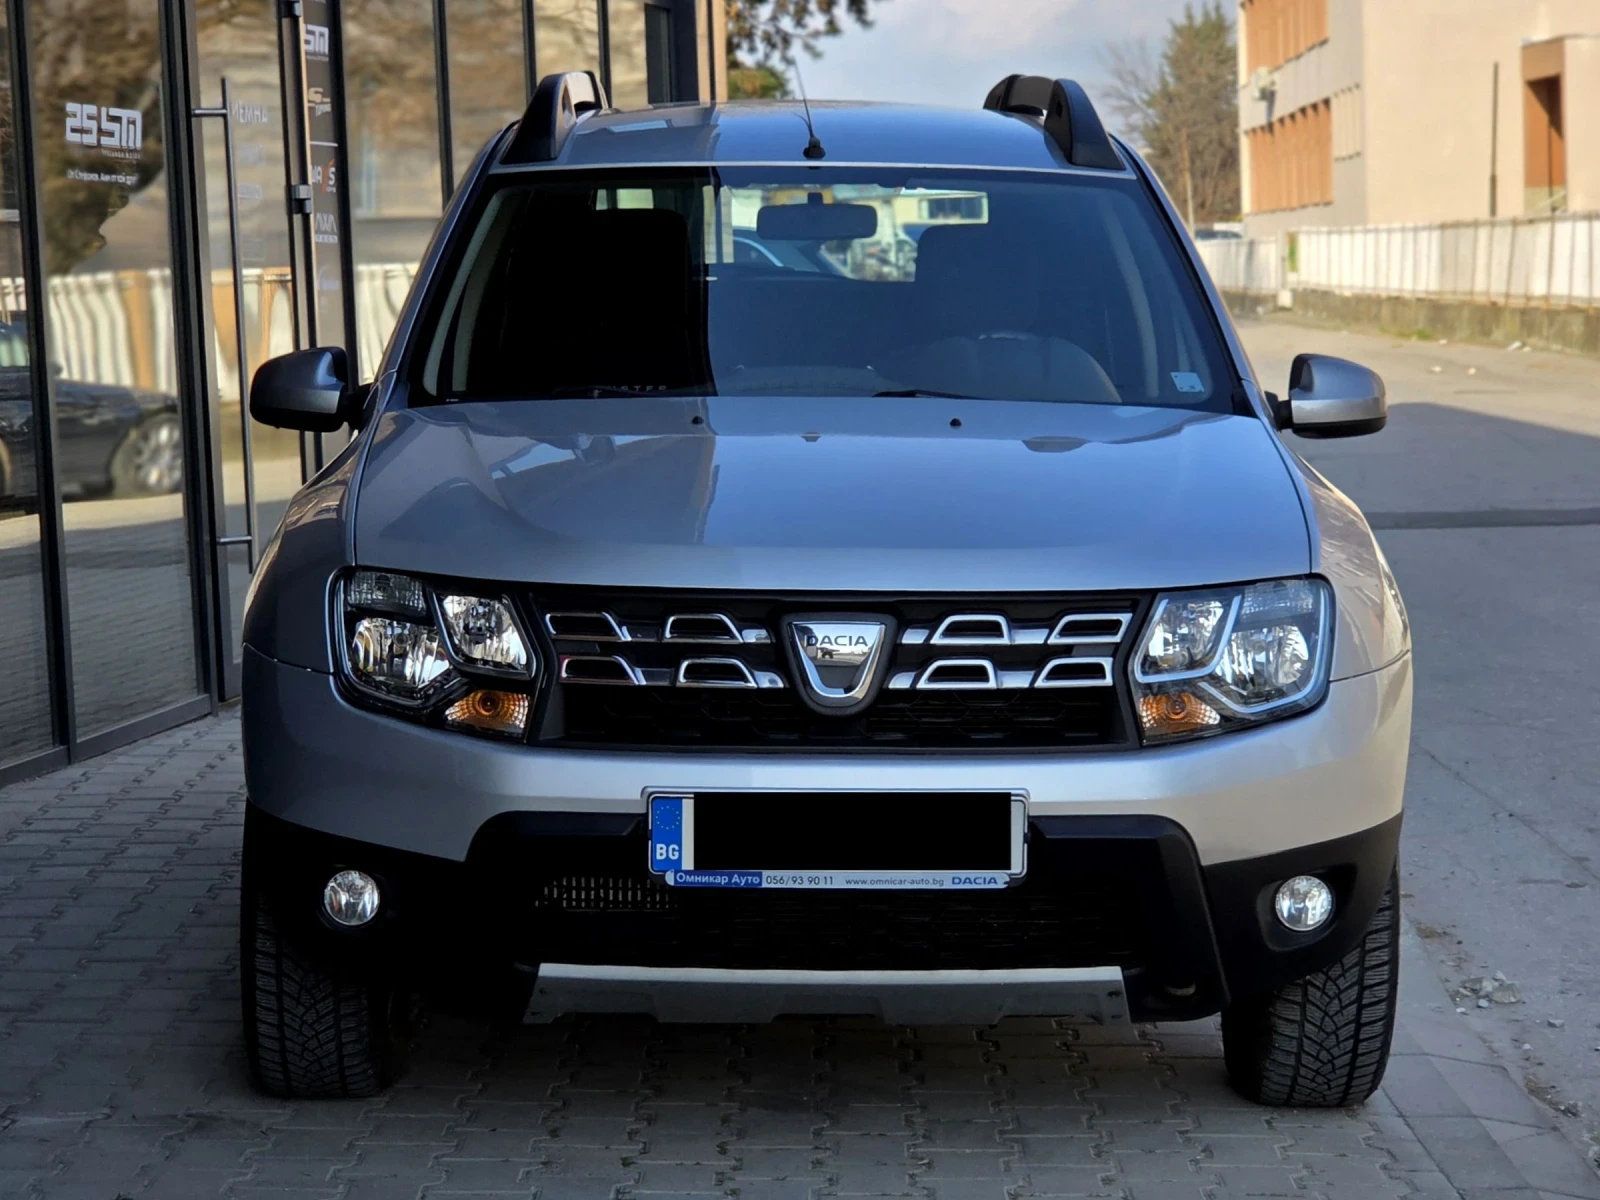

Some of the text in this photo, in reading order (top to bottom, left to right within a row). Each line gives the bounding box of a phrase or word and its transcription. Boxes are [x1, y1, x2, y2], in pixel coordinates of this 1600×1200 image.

[803, 635, 869, 647] DACIA
[656, 843, 680, 860] BG
[676, 873, 761, 887] Омникар Ауто
[765, 875, 834, 886] 056/93 90 11
[845, 876, 945, 887] www.omnicar-auto.bg
[951, 876, 999, 886] DACIA
